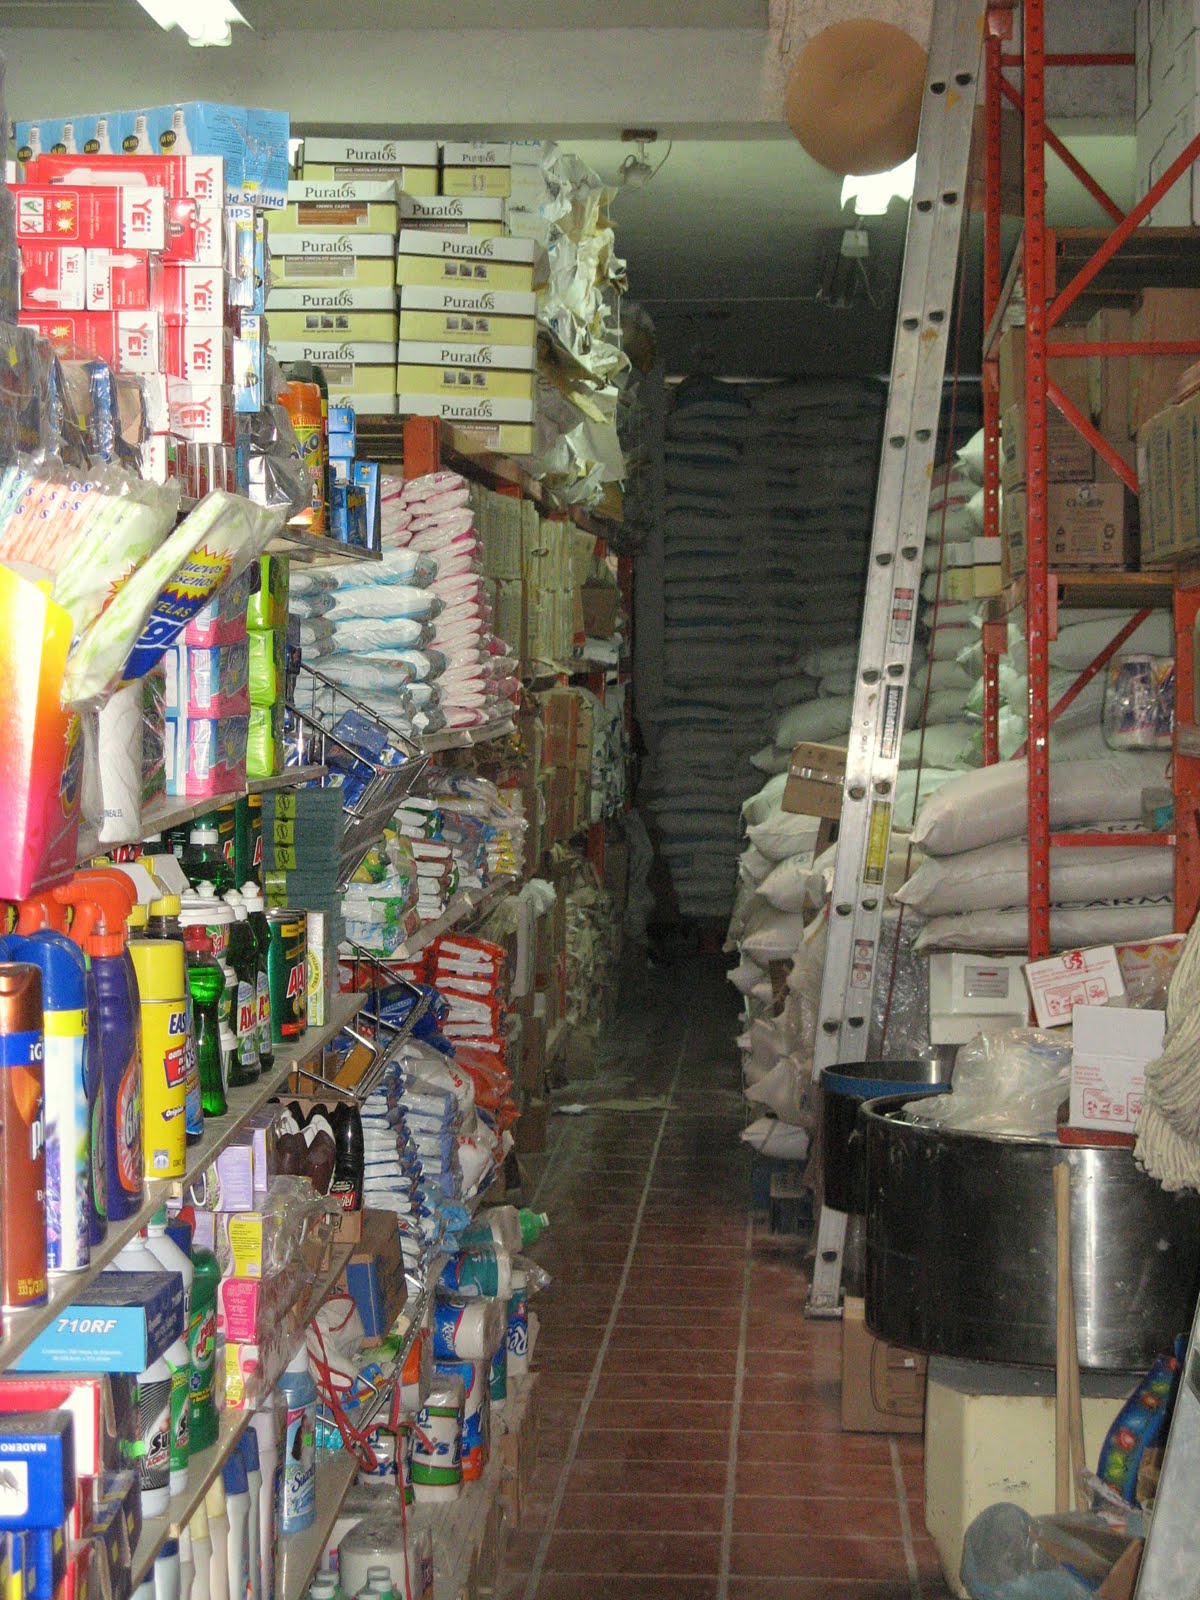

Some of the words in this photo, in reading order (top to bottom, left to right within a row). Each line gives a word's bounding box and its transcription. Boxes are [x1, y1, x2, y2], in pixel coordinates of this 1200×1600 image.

[346, 146, 397, 160] Puratos
[195, 168, 213, 199] YEI
[305, 185, 356, 198] Puratos
[132, 199, 152, 232] YEI
[413, 202, 463, 216] Puratos
[301, 239, 353, 252] Puratos
[442, 240, 494, 256] Puratos
[194, 280, 213, 312] YEI
[302, 293, 354, 306] Puratos
[443, 295, 495, 309] Puratos
[128, 322, 148, 356] YEI
[194, 338, 212, 370] YEI
[303, 346, 355, 360] Puratos
[441, 349, 492, 364] Puratos
[441, 403, 493, 417] Puratos
[57, 1318, 117, 1334] 710RF
[419, 1408, 427, 1420] 4
